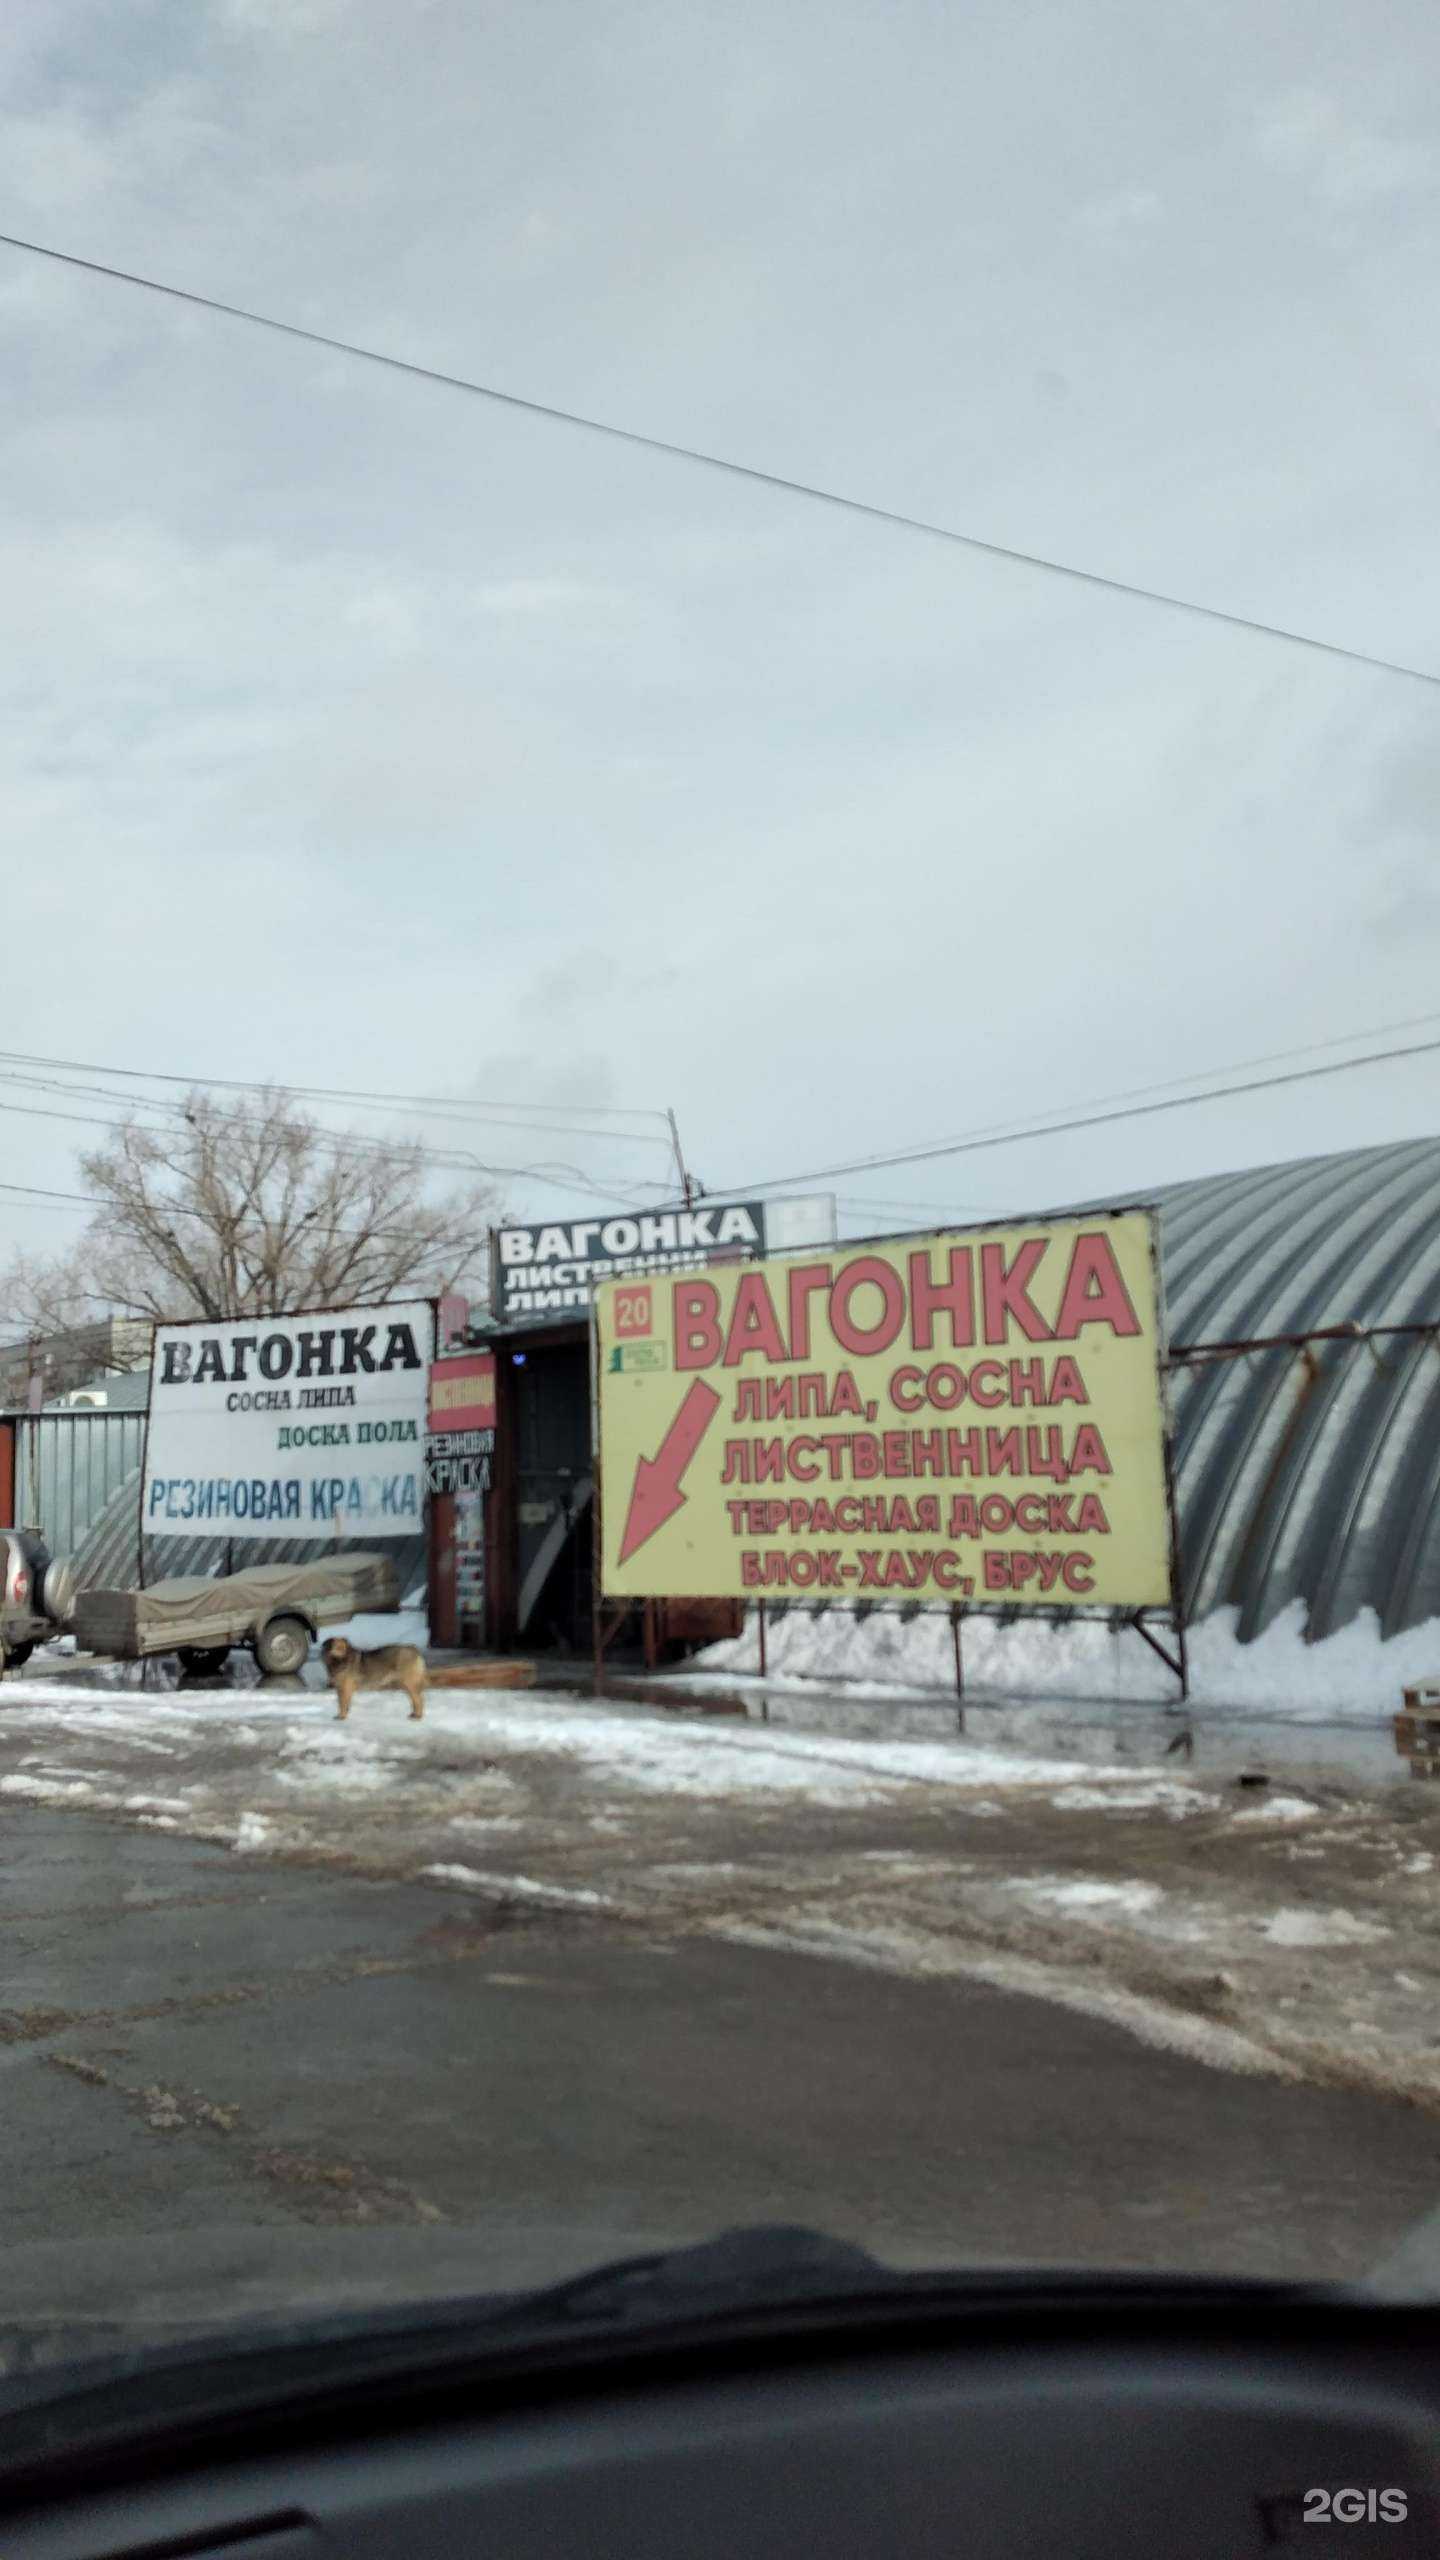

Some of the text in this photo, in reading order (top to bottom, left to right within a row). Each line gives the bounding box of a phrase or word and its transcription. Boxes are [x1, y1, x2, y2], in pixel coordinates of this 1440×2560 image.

[500, 1205, 761, 1266] ВАГОНКА
[504, 1286, 590, 1312] ЛИП
[618, 1296, 649, 1329] 20
[673, 1231, 1142, 1373] ВАГОНКА
[160, 1323, 422, 1385] ВАГОНКА
[227, 1386, 357, 1413] СОСНА ЛИПА
[733, 1355, 1091, 1423] ЛИПА, СОСНА
[278, 1419, 419, 1451] ДОСКА ПОЛА
[721, 1423, 1113, 1485] ЛИСТВЕННИЦА
[149, 1473, 419, 1520] РЕЗИНОВАЯ КРАКА
[727, 1494, 1112, 1540] ТЕРРАСНАЯ ДОСКА
[741, 1550, 1096, 1596] БЛОК-ХАУС, БРУС
